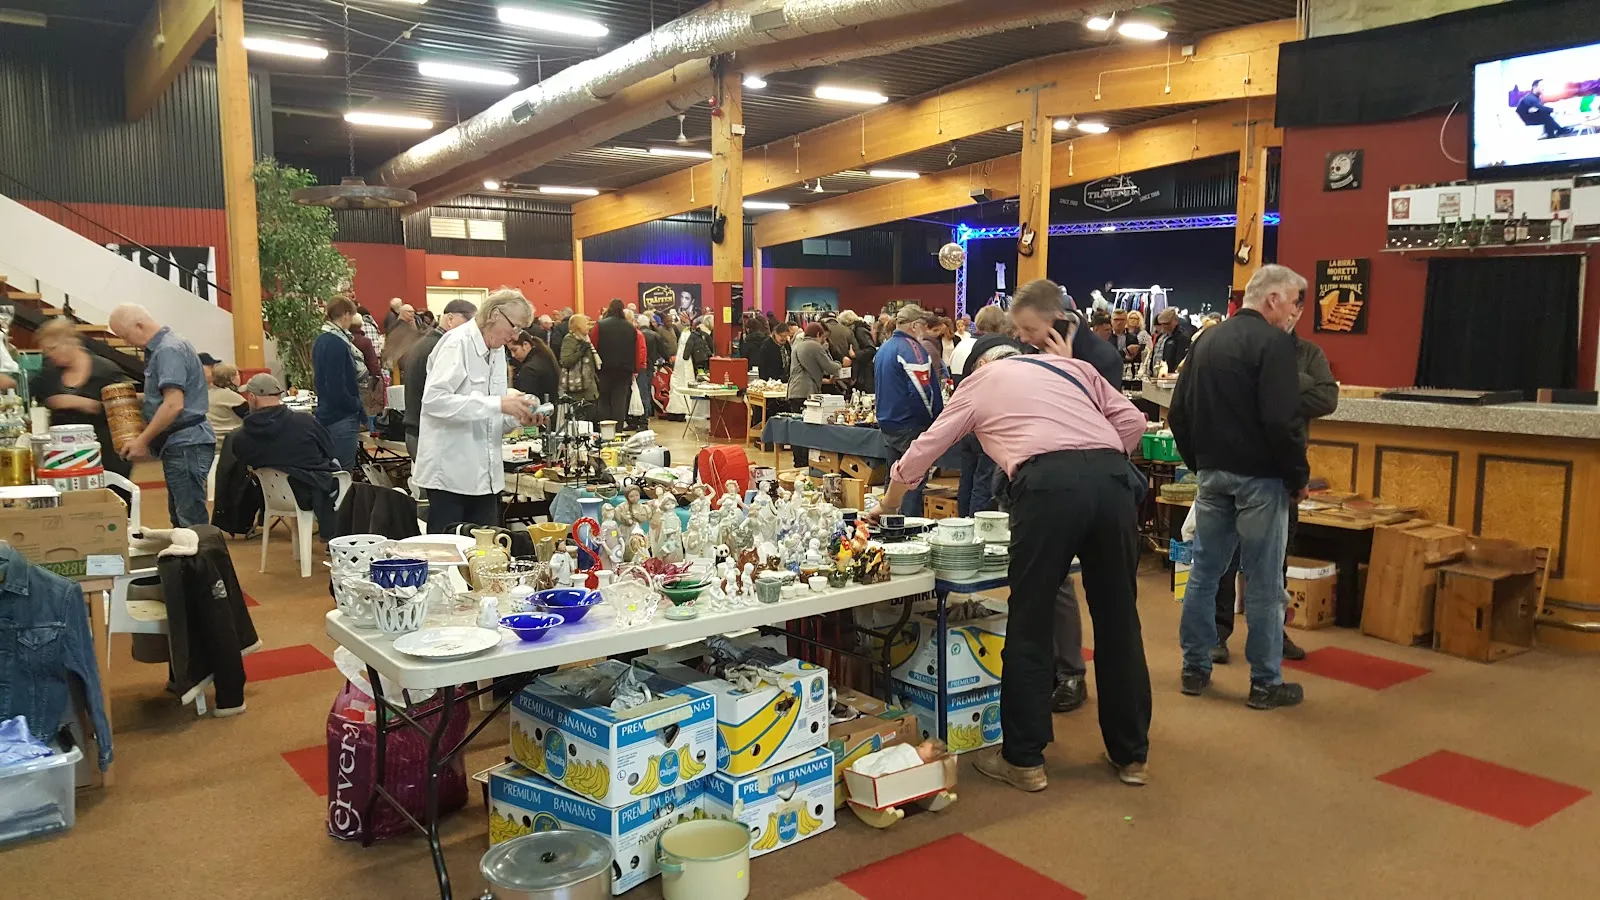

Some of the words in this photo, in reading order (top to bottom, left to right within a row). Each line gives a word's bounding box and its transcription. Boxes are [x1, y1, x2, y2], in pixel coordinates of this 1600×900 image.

[1327, 267, 1358, 275] MORETTI
[1337, 259, 1356, 267] BIRRA
[950, 677, 976, 688] PREMIUM
[904, 686, 933, 702] BANANAS
[951, 691, 990, 708] PREMIUM
[519, 697, 554, 719] PREMIUM
[557, 713, 598, 739] BANANAS
[545, 750, 566, 768] Chiquita
[660, 765, 679, 777] Chiquita
[789, 760, 828, 780] BANANAS
[503, 784, 541, 805] PREMIUM
[553, 798, 597, 821] BANANAS
[780, 822, 796, 833] Chiquita
